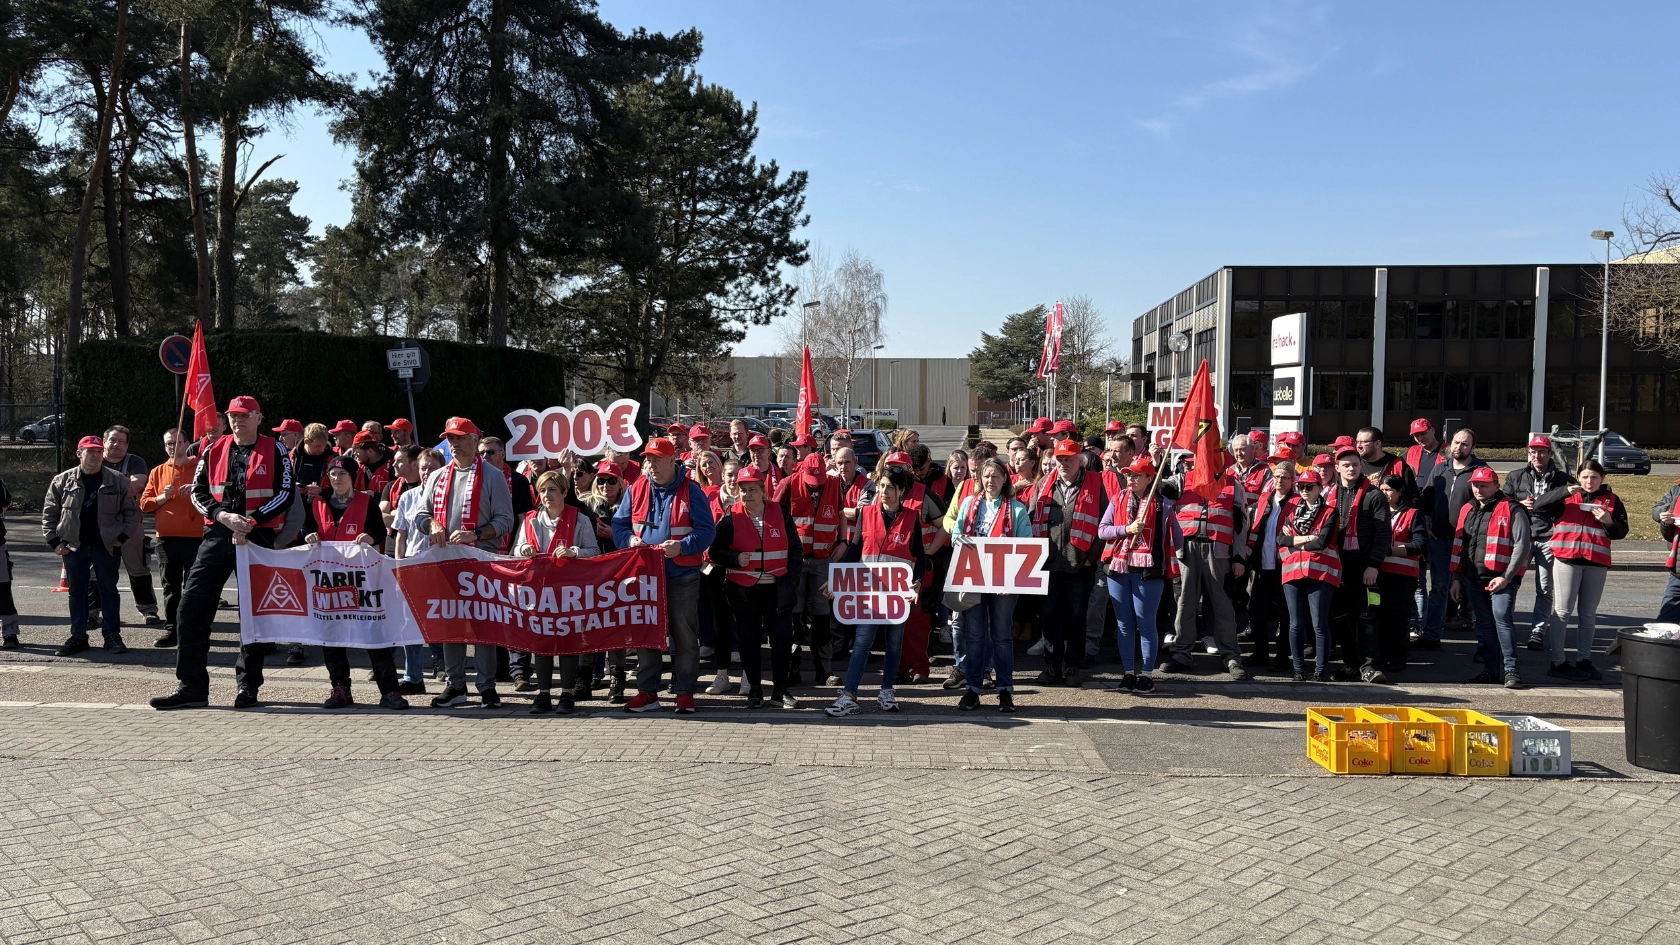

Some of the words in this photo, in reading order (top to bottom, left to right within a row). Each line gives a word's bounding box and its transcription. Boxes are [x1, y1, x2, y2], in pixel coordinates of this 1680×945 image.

[391, 351, 404, 359] Hier
[406, 351, 416, 359] gilt
[511, 404, 636, 455] 200€
[282, 457, 292, 489] adidas
[310, 569, 366, 588] TARIF
[951, 544, 1043, 588] ATZ
[832, 567, 910, 592] MEHR
[457, 571, 658, 614] SOLIDARISCH
[343, 613, 387, 621] BEKLEIDUNG
[426, 598, 524, 629] ZUKUNFT
[528, 605, 658, 637] GESTALTEN
[837, 594, 906, 620] GELD
[1351, 757, 1374, 767] Coke
[1408, 756, 1431, 765] Coke
[1469, 758, 1495, 768] Coke
